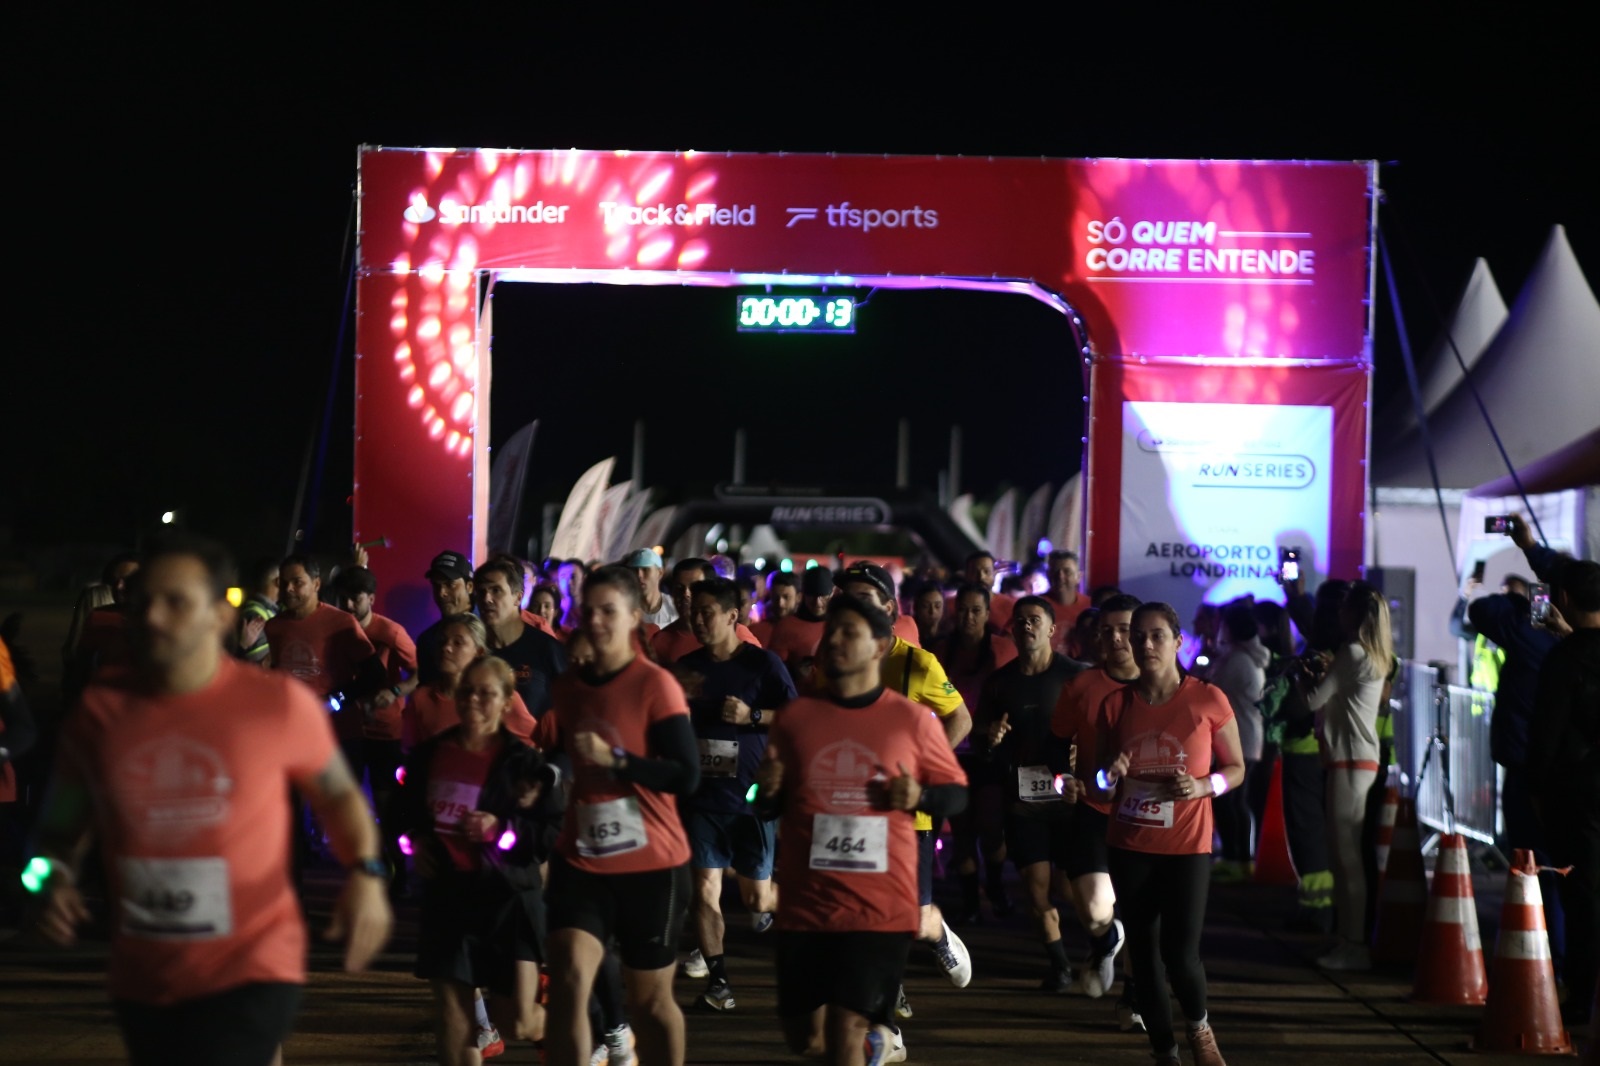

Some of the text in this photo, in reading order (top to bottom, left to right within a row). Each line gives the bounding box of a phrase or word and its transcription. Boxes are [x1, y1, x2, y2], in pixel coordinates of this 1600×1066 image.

[437, 200, 569, 225] Santander
[825, 202, 939, 232] tfsports
[1086, 216, 1217, 245] SÓ QUEM
[1085, 247, 1316, 274] CORRE ENTENDE
[1145, 542, 1271, 561] AEROPORTO
[1170, 561, 1279, 580] LONDRINA
[1031, 779, 1052, 792] 331
[1124, 796, 1162, 815] 4745
[825, 836, 866, 854] 464
